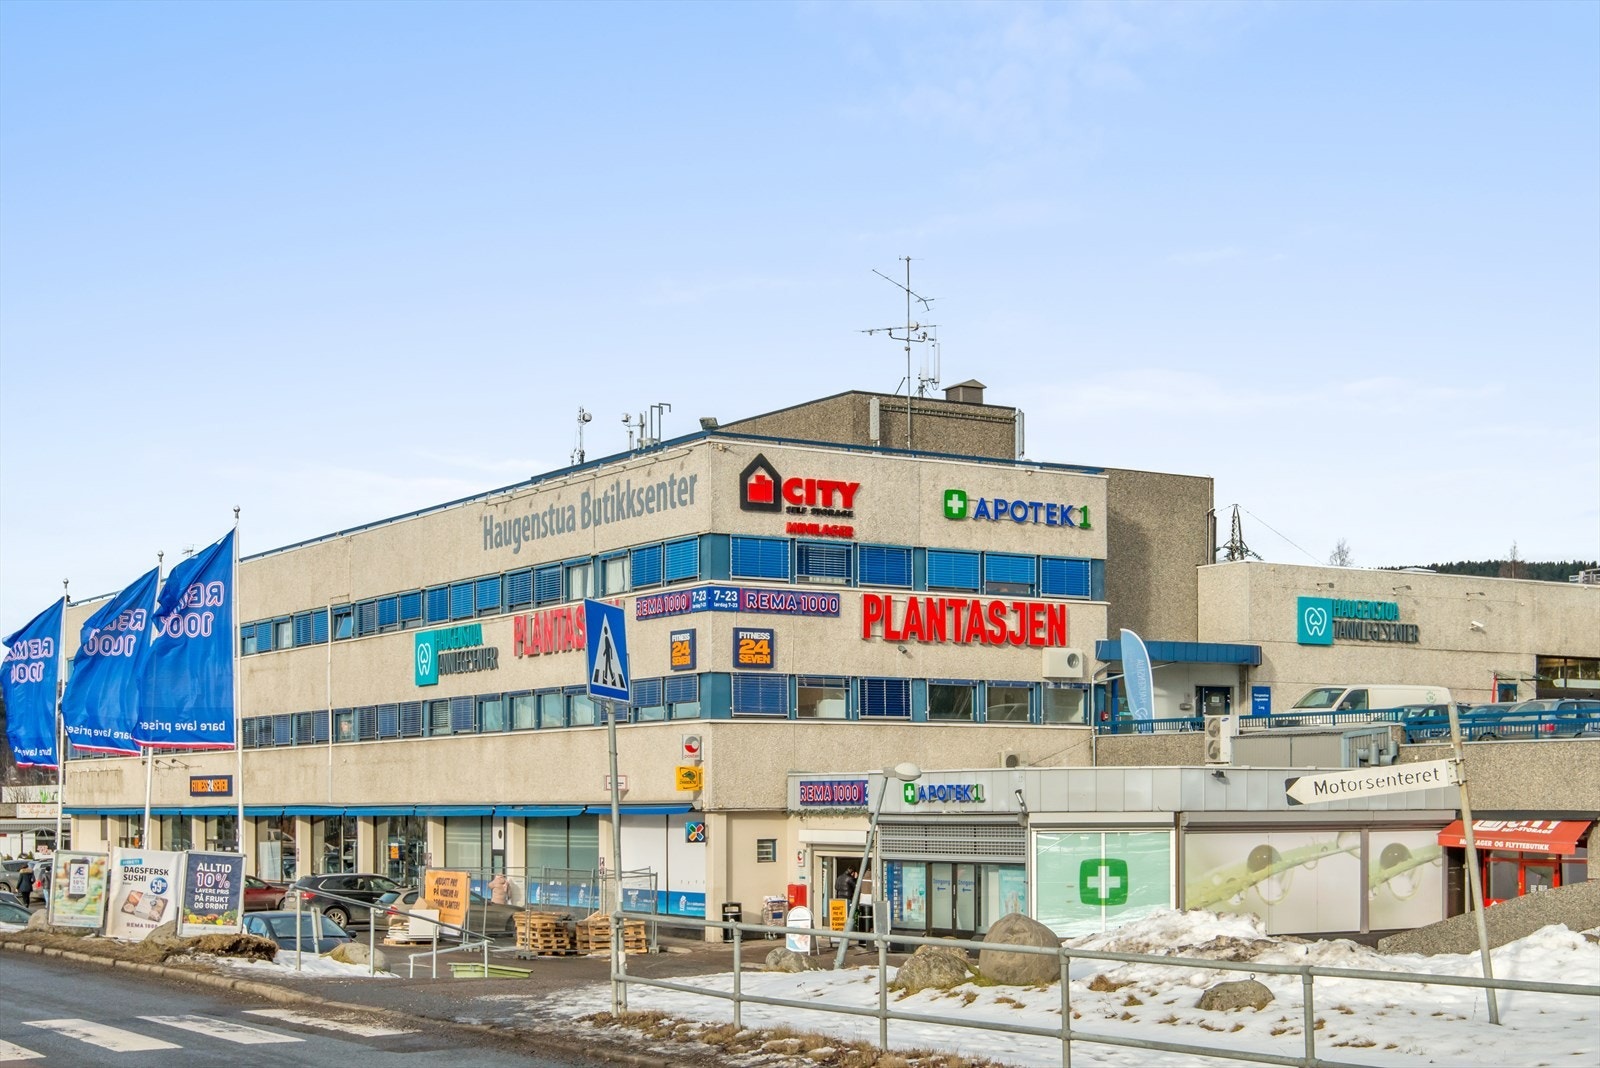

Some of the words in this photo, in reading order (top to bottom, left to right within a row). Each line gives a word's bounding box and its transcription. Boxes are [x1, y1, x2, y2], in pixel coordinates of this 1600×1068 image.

[782, 477, 861, 509] CITY
[483, 503, 576, 554] Haugenstua
[580, 473, 698, 530] Butikksenter
[786, 505, 807, 515] SELF
[810, 507, 854, 518] STORAGE
[973, 497, 1075, 527] APOTEK
[1079, 505, 1092, 528] 1
[786, 521, 855, 539] MINILAGER
[636, 600, 663, 617] REMA
[664, 594, 687, 612] 1000
[692, 590, 707, 602] 7-23
[714, 590, 738, 601] 7-23
[746, 592, 797, 611] REMA
[801, 596, 839, 612] 1000
[1333, 599, 1399, 620] HAUGENSTUA
[862, 593, 1069, 647] PLANTASJEN
[671, 633, 690, 641] FITNESS
[739, 631, 770, 640] FITNESS
[672, 641, 690, 656] 24
[739, 639, 770, 655] 24
[672, 656, 690, 665] SEVEN
[739, 654, 770, 665] SEVEN
[1313, 767, 1440, 796] Motorsenteret
[800, 786, 832, 802] REMA
[833, 785, 859, 801] 1000
[919, 785, 972, 801] APOTEK
[973, 784, 983, 801] 1
[1459, 838, 1492, 847] MAGER
[1494, 840, 1504, 848] OG
[1505, 841, 1549, 851] FLYTTEBUTIKK
[123, 866, 169, 876] DAGSFERSK
[197, 863, 232, 873] ALLTID
[123, 874, 146, 882] SUSHI
[196, 872, 231, 889] 10%
[194, 894, 204, 902] PÅ
